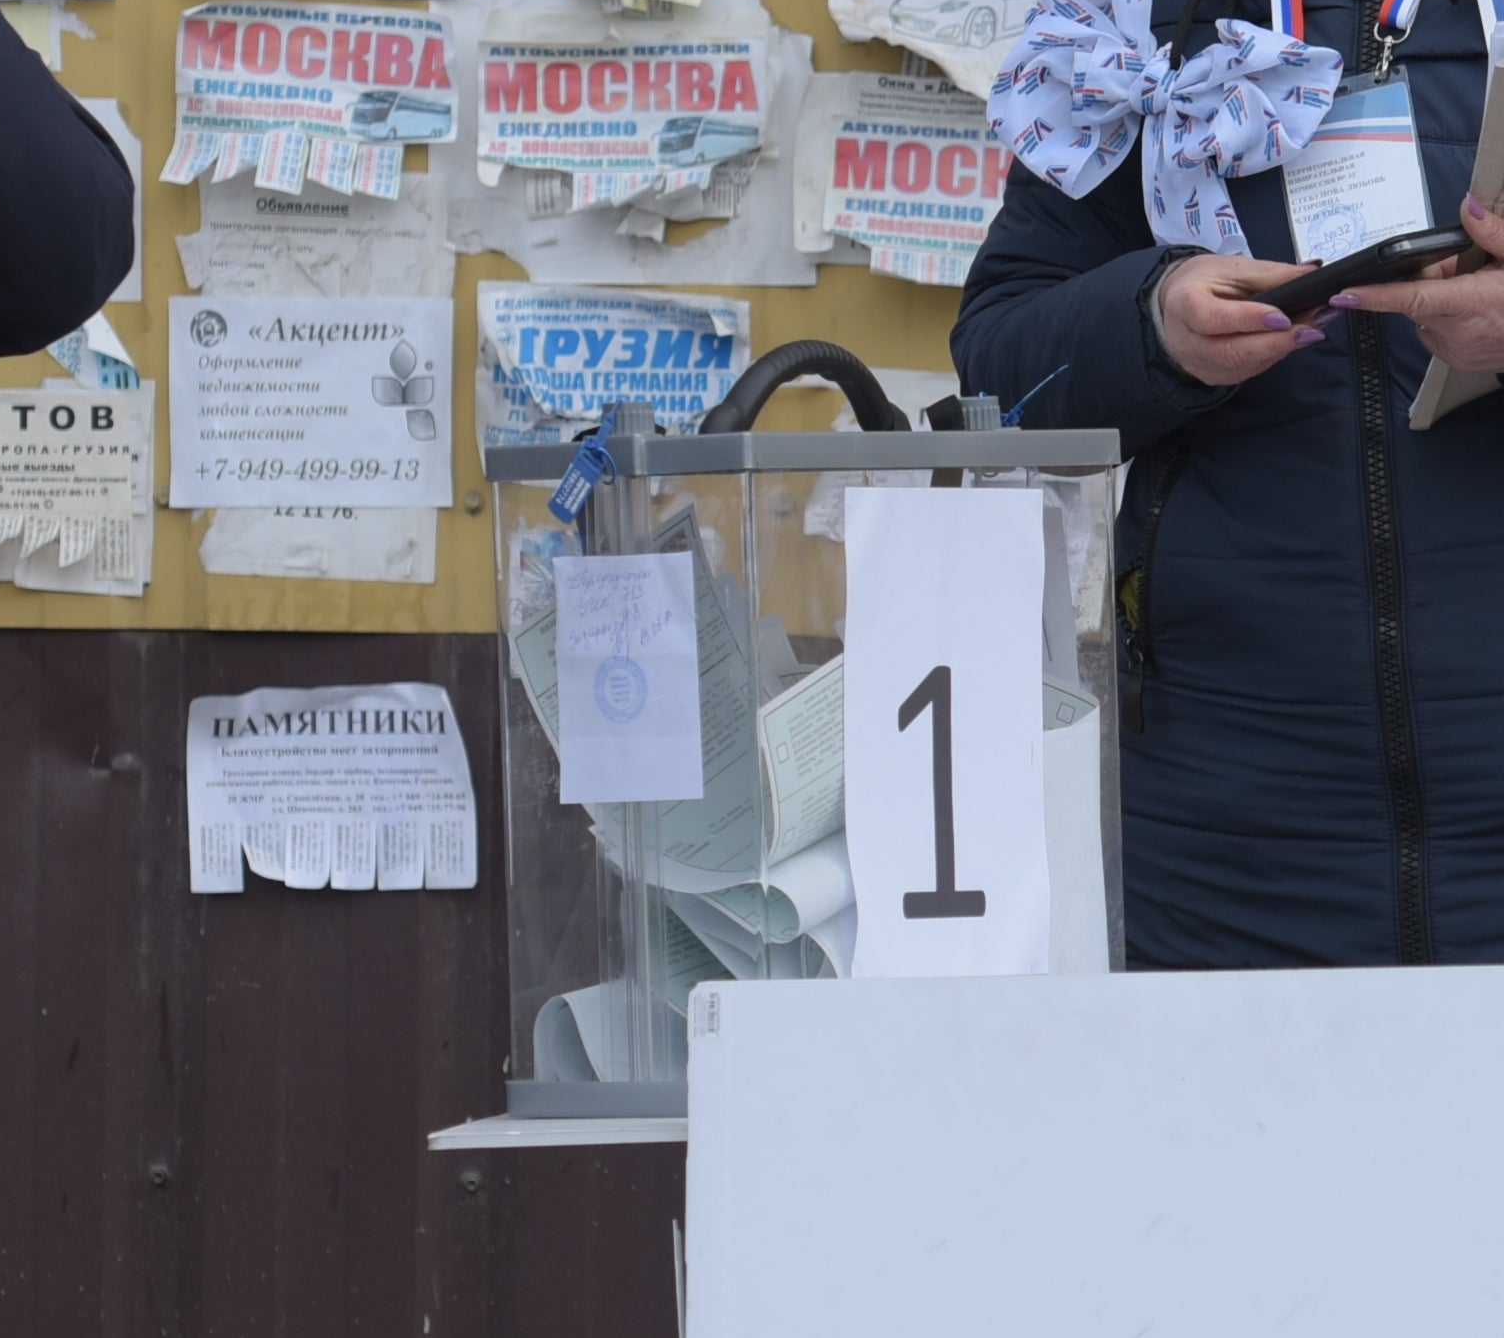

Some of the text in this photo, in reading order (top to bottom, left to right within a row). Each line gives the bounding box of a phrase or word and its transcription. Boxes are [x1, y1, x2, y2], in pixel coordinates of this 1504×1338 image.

[180, 19, 452, 89] МОСКВА
[192, 78, 333, 104] ЕЖЕДНЕВНО
[484, 60, 759, 114] МОСКВА
[497, 119, 637, 139] ЕЖЕДНЕВНО
[843, 198, 986, 222] ЕЖЕДНЕВНО
[248, 318, 405, 344] «Акцент»
[518, 327, 734, 370] ГРУЗИЯ
[198, 354, 303, 372] Оформление
[198, 377, 321, 394] недвижимости
[198, 400, 349, 418] любой сложности
[198, 425, 306, 443] компенсации
[195, 458, 420, 483] +7-949-499-99-13
[212, 706, 447, 741] ПАМЯТНИКИ
[896, 663, 987, 919] 1
